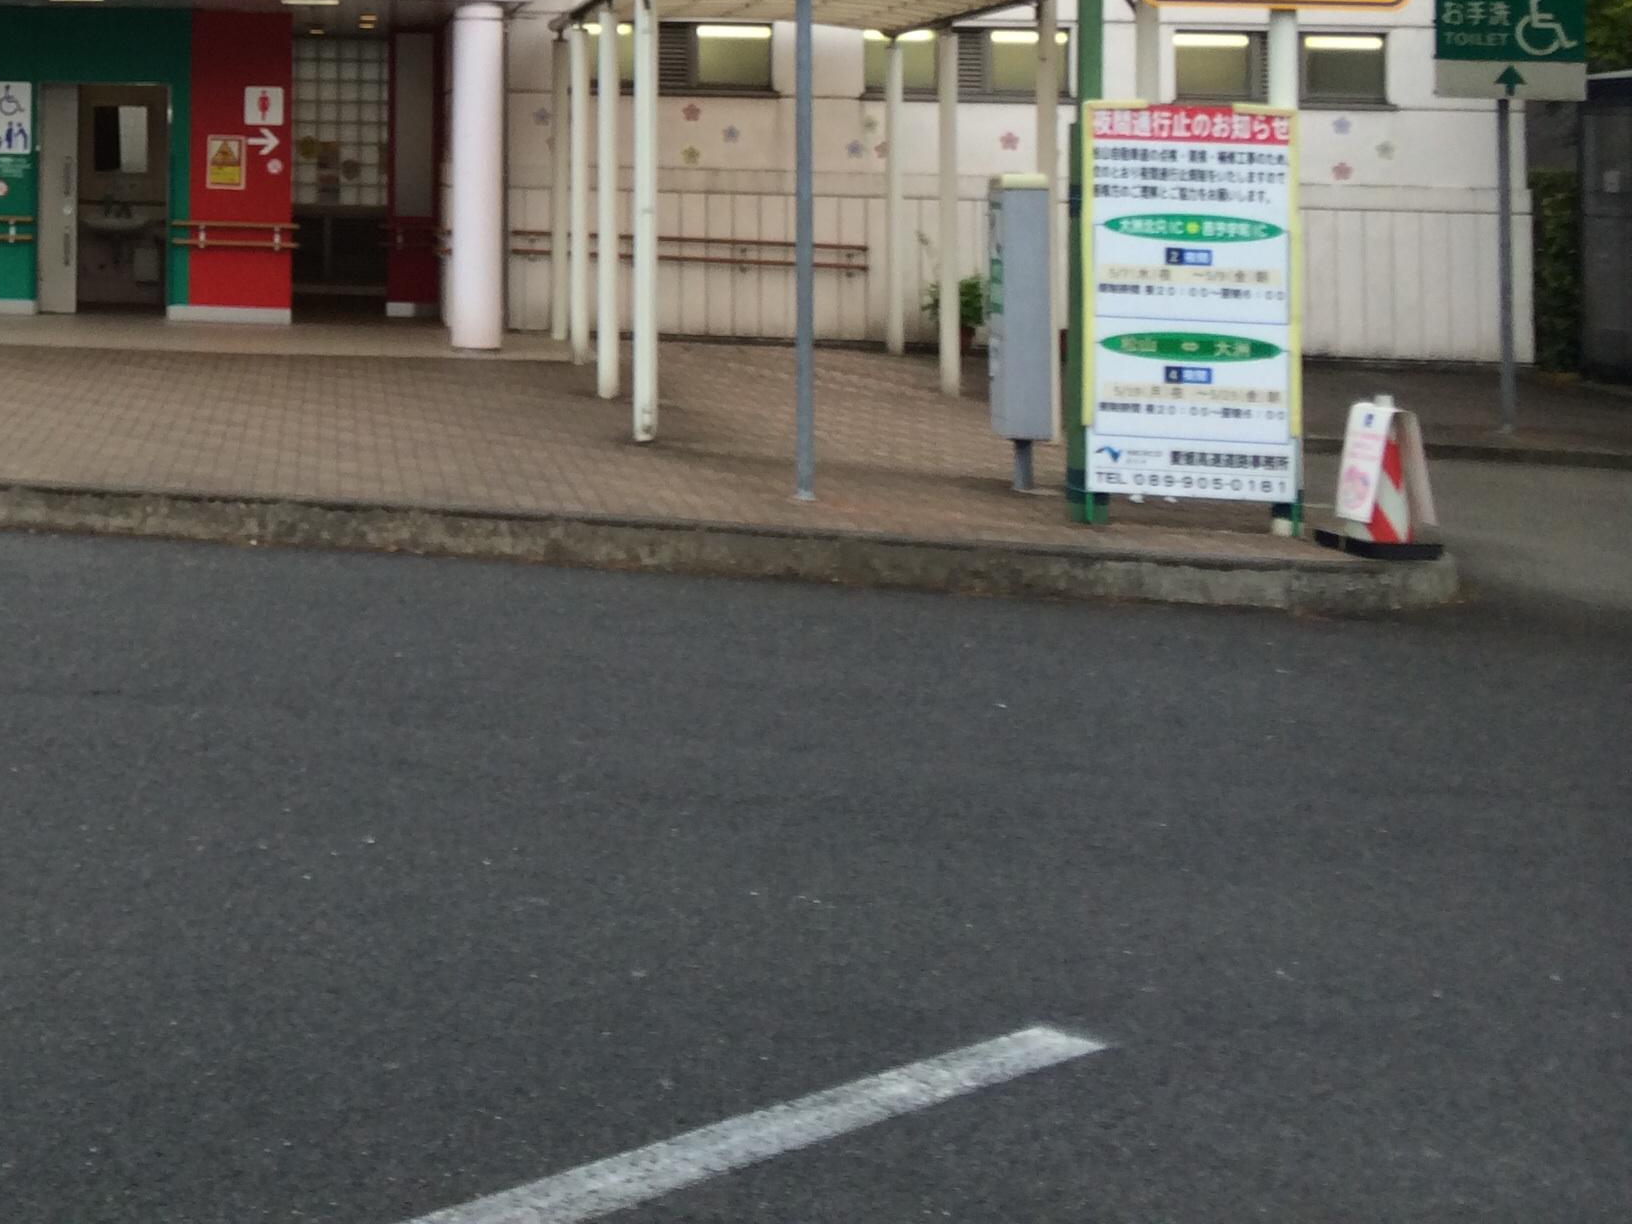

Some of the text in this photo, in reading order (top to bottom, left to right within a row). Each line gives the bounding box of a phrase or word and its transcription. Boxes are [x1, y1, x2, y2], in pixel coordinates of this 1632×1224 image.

[1441, 1, 1511, 25] お手洗
[1444, 32, 1509, 46] TOILET
[1096, 471, 1287, 493] TEL 089-905-0181
